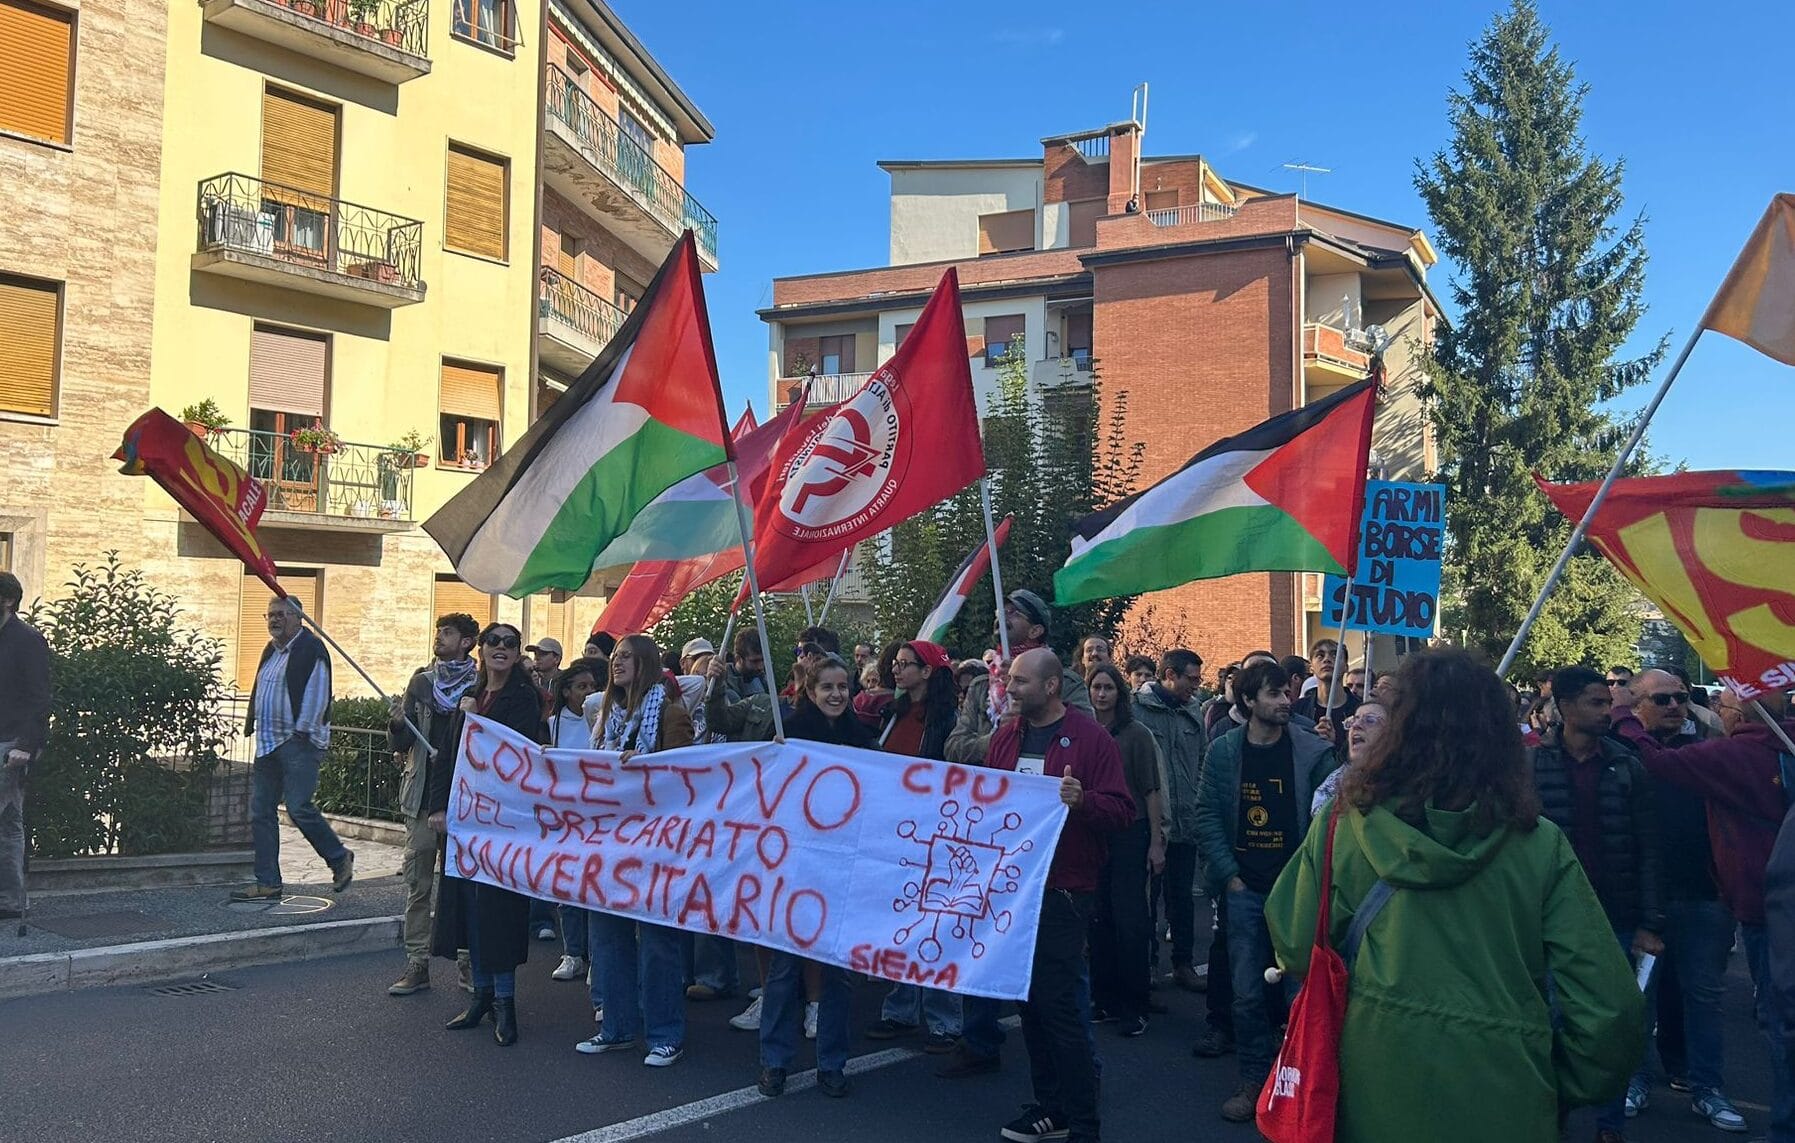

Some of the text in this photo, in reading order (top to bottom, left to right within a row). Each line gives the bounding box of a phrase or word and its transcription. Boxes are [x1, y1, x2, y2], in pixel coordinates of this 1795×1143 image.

[1372, 487, 1440, 523] ARMI
[1365, 521, 1440, 561] BORSE
[1369, 559, 1395, 586] DI
[1332, 583, 1436, 629] STUDIO
[464, 721, 862, 830] COLLETTIVO
[901, 762, 1010, 802] CPU
[457, 777, 789, 870] DEL PRECARIATO
[452, 835, 827, 950] UNIVERSITARIO
[850, 943, 958, 988] SIENA
